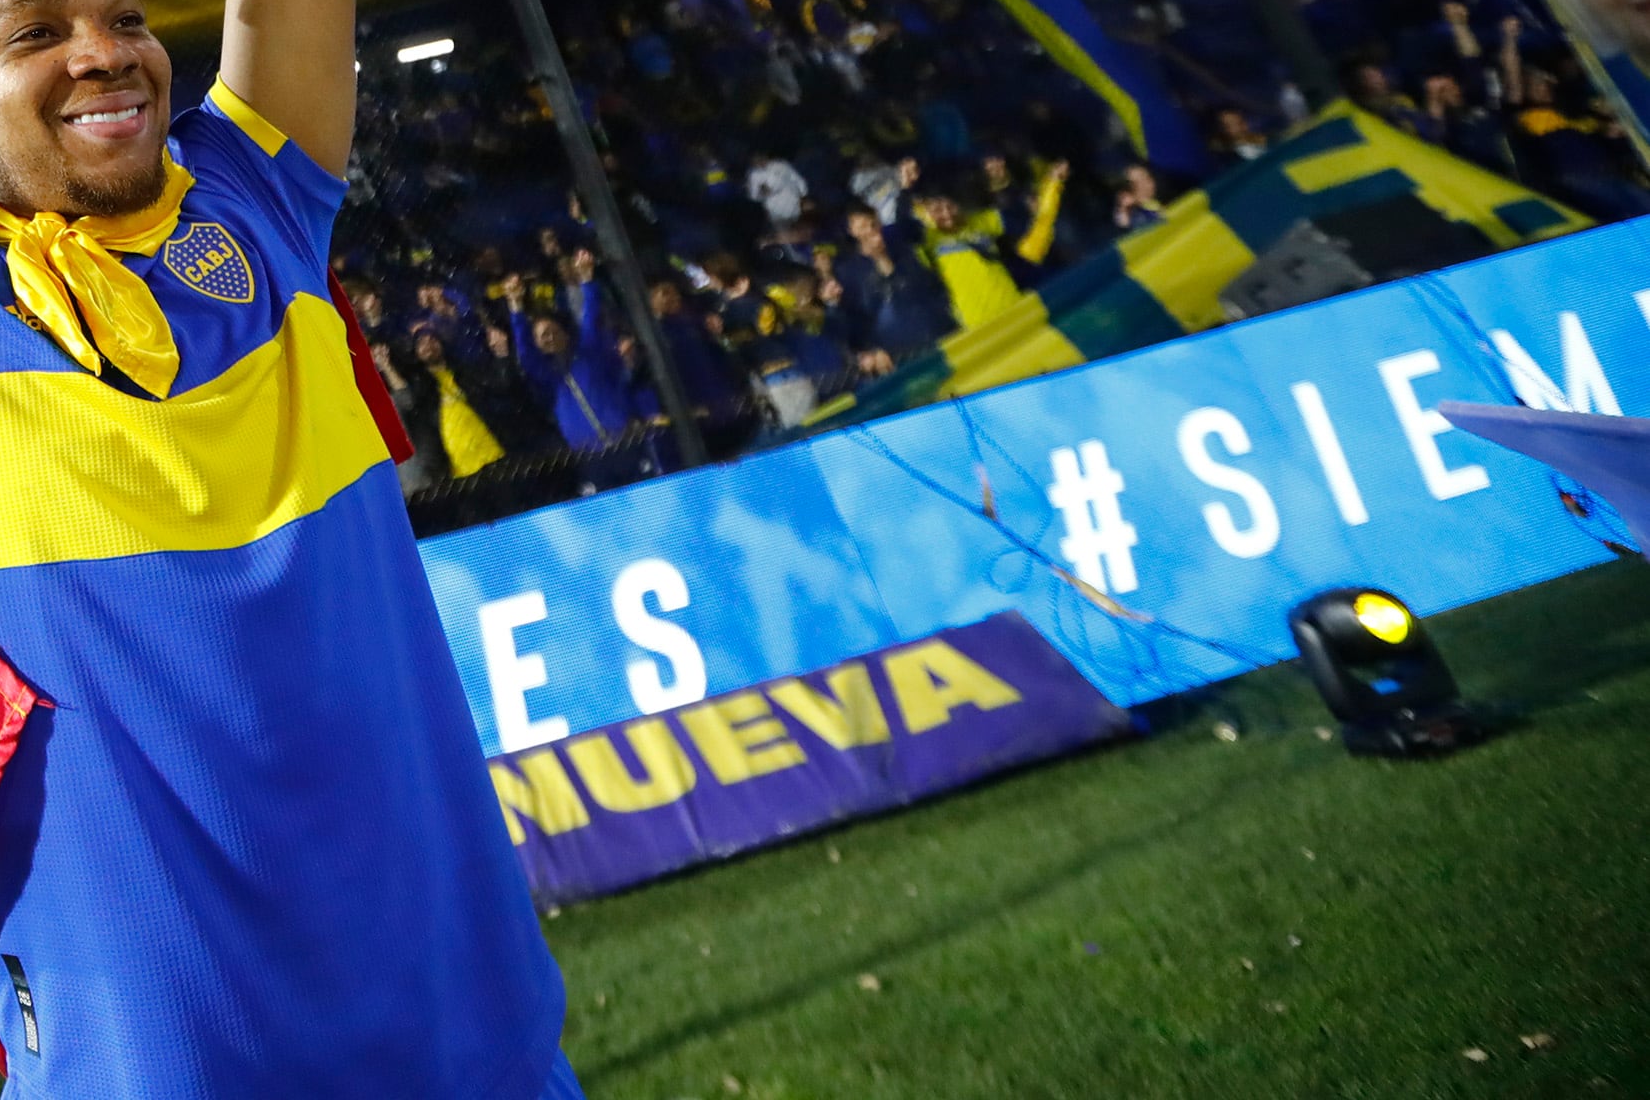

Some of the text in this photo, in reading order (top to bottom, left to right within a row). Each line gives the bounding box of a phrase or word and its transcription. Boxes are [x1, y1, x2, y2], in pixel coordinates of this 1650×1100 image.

[184, 241, 234, 283] CABJ
[1048, 286, 1650, 594] #SIEM
[489, 638, 1023, 845] NUEVA
